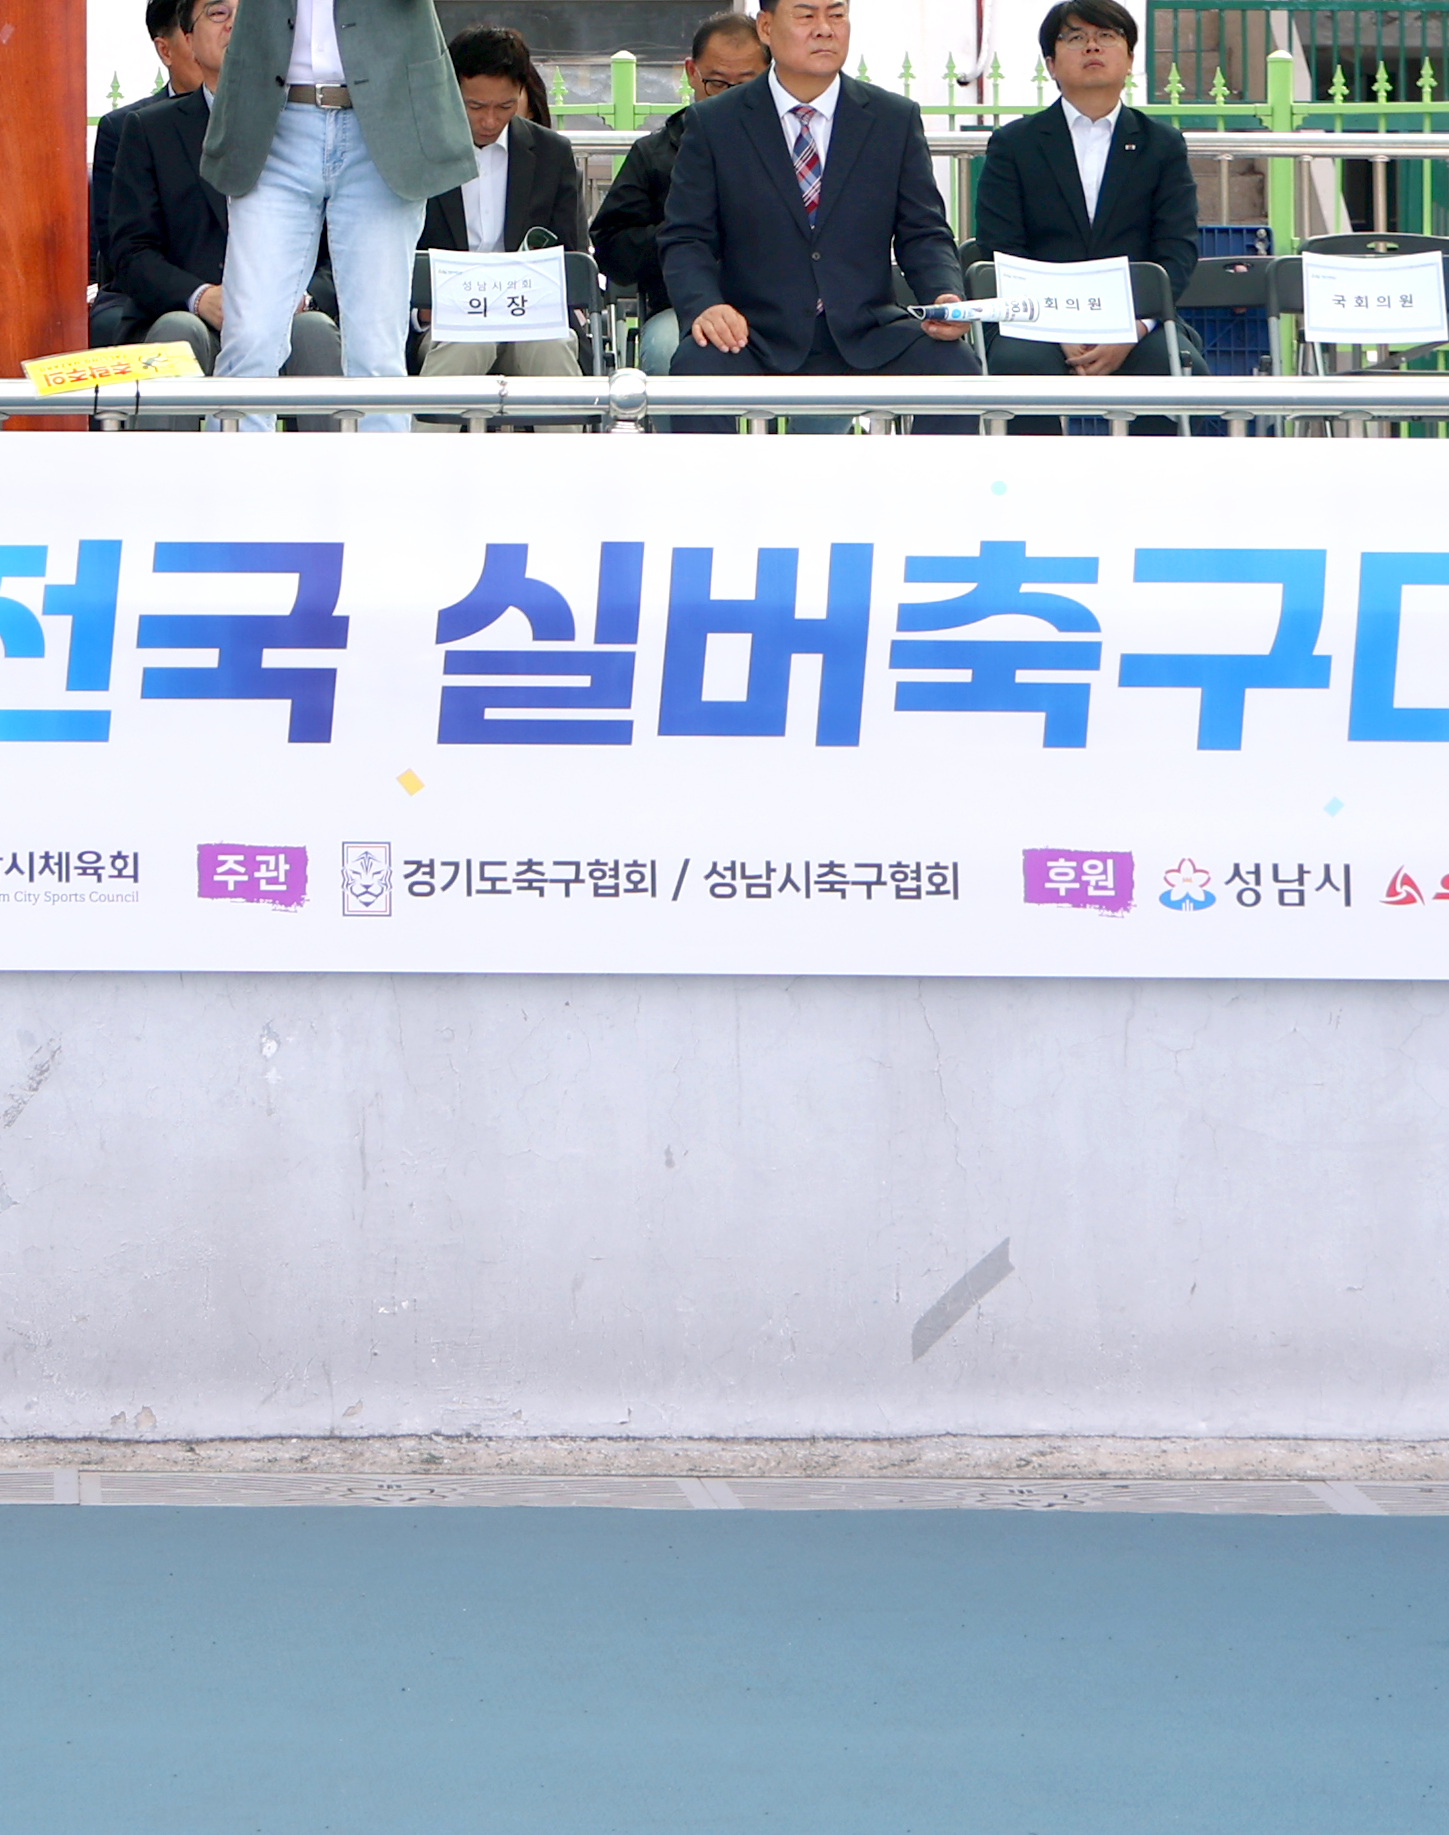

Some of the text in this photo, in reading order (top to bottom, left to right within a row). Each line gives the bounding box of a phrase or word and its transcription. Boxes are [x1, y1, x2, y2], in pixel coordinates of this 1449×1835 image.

[1333, 294, 1413, 309] 국회의원
[44, 362, 132, 387] 추락주의
[213, 852, 958, 901] 주관 경기도축구협회 / 성남시축구협회
[1045, 858, 1351, 907] 후원 성남시
[14, 891, 40, 905] City
[44, 891, 85, 905] Sports
[89, 891, 138, 902] Council
